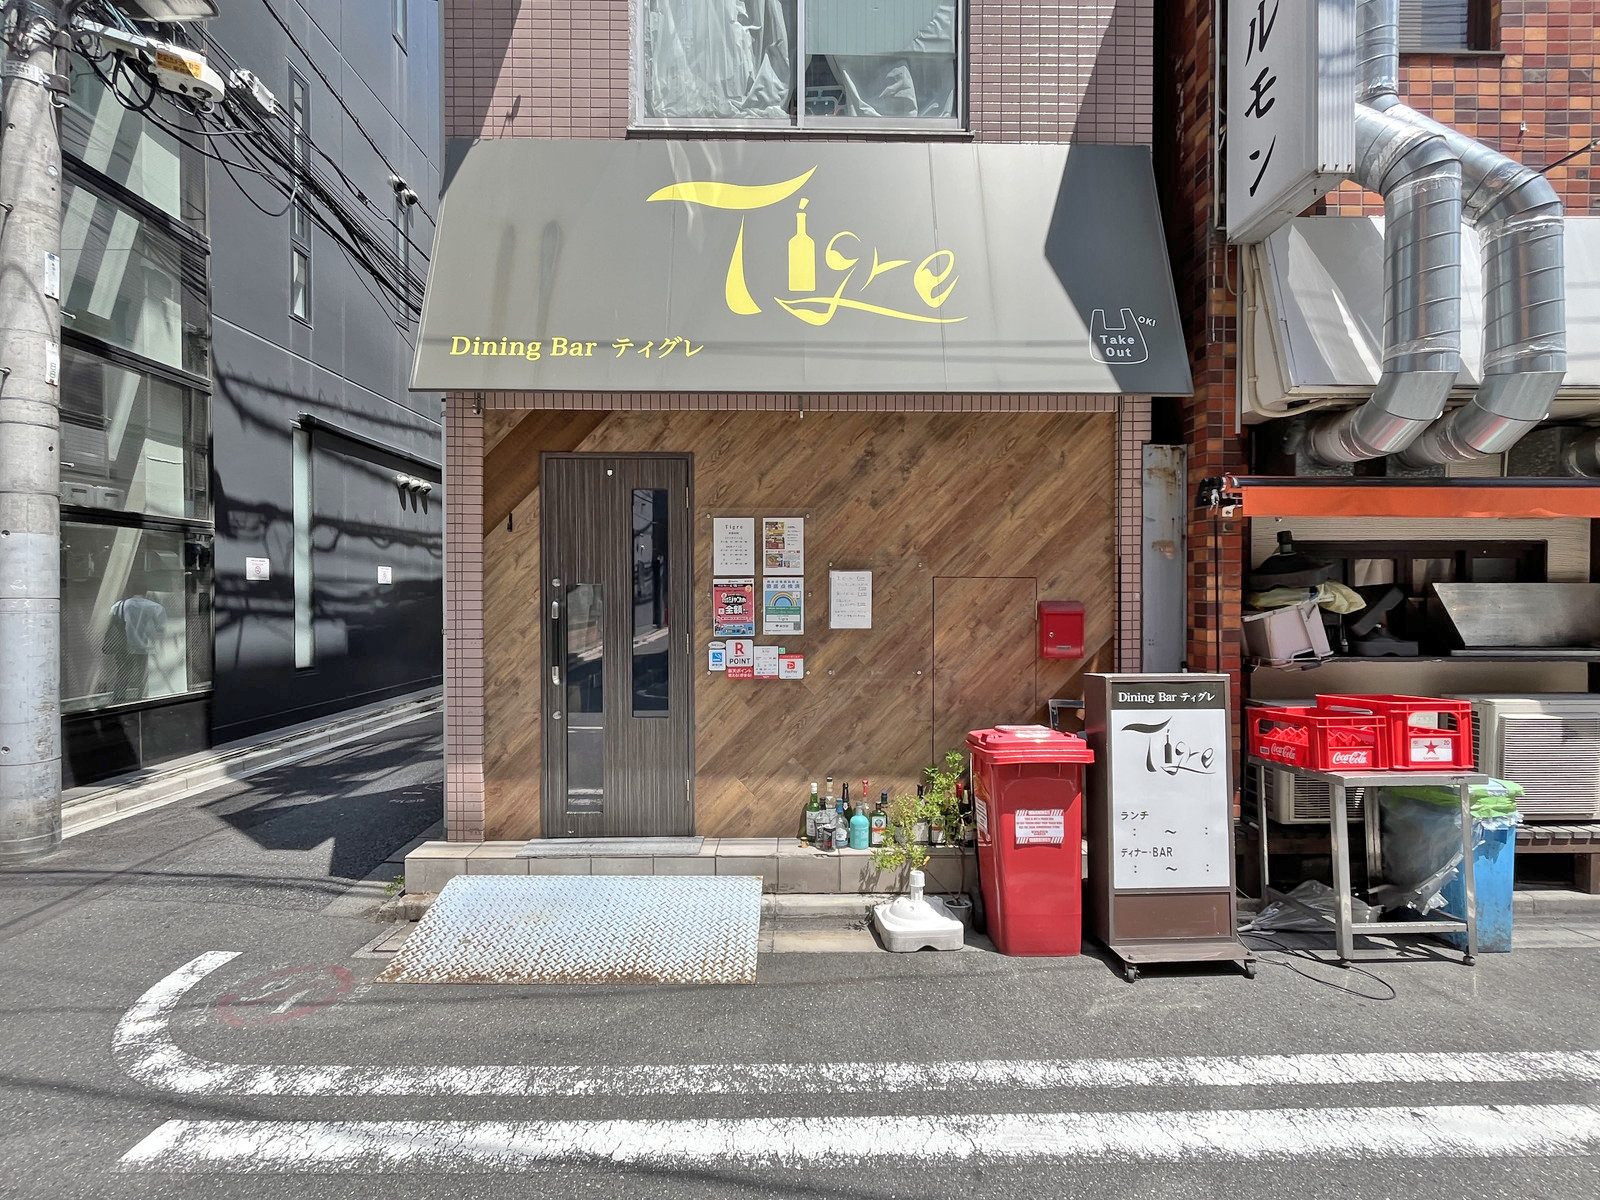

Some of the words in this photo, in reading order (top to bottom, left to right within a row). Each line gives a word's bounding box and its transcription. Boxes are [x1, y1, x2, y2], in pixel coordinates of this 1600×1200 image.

[1245, 0, 1280, 197] ルモン
[646, 165, 968, 326] Tigre
[1099, 335, 1135, 345] Take
[450, 336, 541, 361] Dining
[550, 336, 597, 357] Bar
[612, 336, 704, 358] ティグレ
[1105, 347, 1132, 357] Out
[1118, 692, 1155, 703] Dining
[1158, 692, 1177, 702] Bar
[1180, 691, 1215, 703] ティグレ
[1121, 716, 1216, 776] Tigre
[1332, 751, 1368, 764] Coca-Cola
[1121, 811, 1149, 820] ランチ
